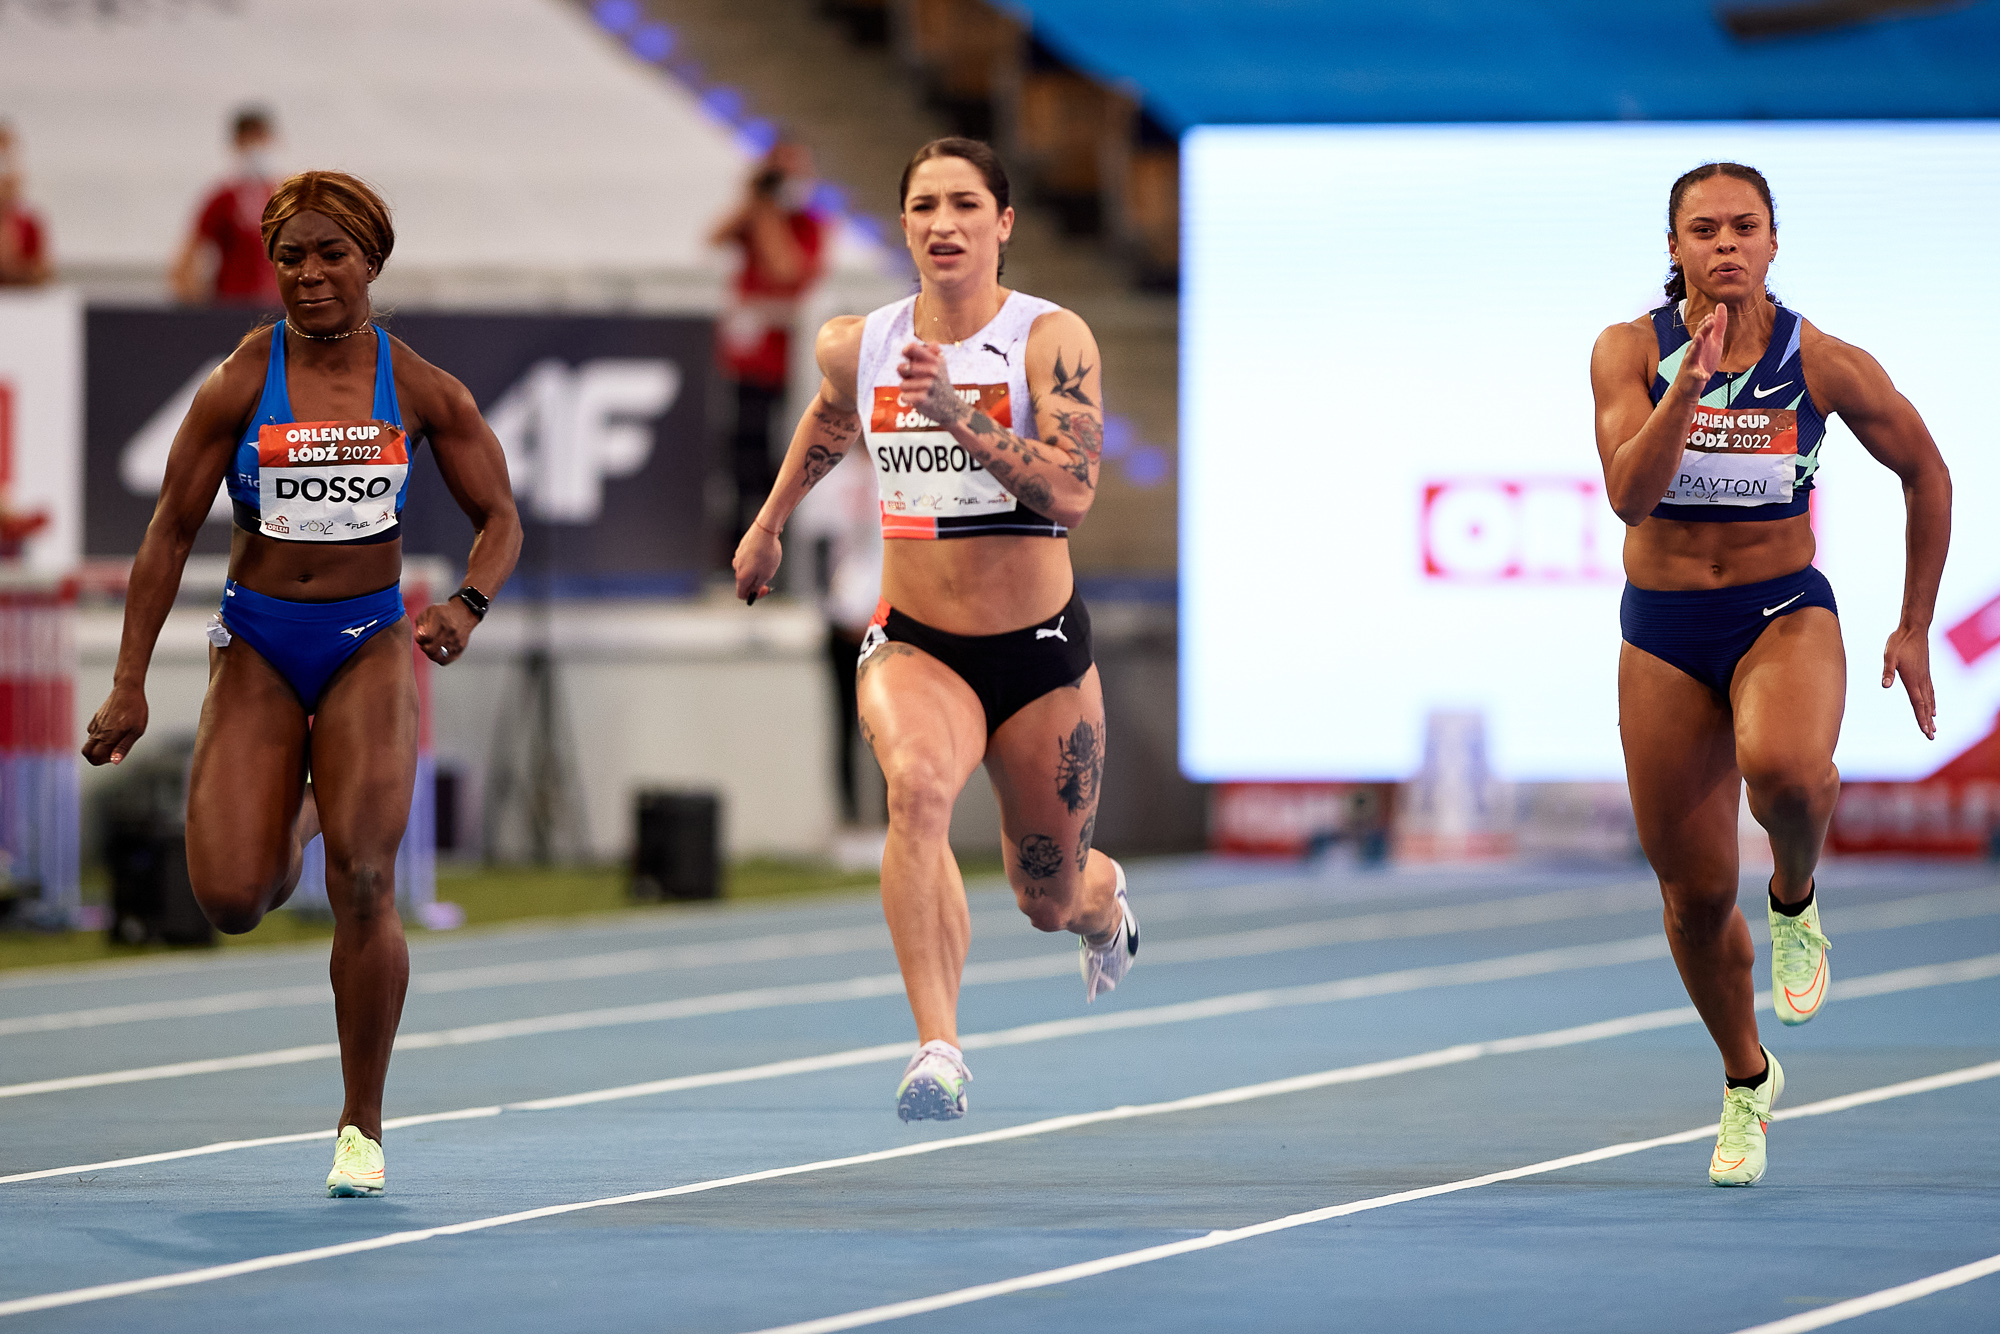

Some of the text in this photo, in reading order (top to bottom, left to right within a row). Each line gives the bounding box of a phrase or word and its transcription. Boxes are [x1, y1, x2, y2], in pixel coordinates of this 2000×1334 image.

[954, 388, 981, 405] UP
[1737, 414, 1770, 429] CUP
[286, 425, 380, 443] ORLEN CUP
[1732, 434, 1771, 449] 2022
[288, 443, 381, 463] ŁÓDŹ 2022
[276, 476, 391, 504] DOSSO
[1679, 474, 1767, 495] PAYTON
